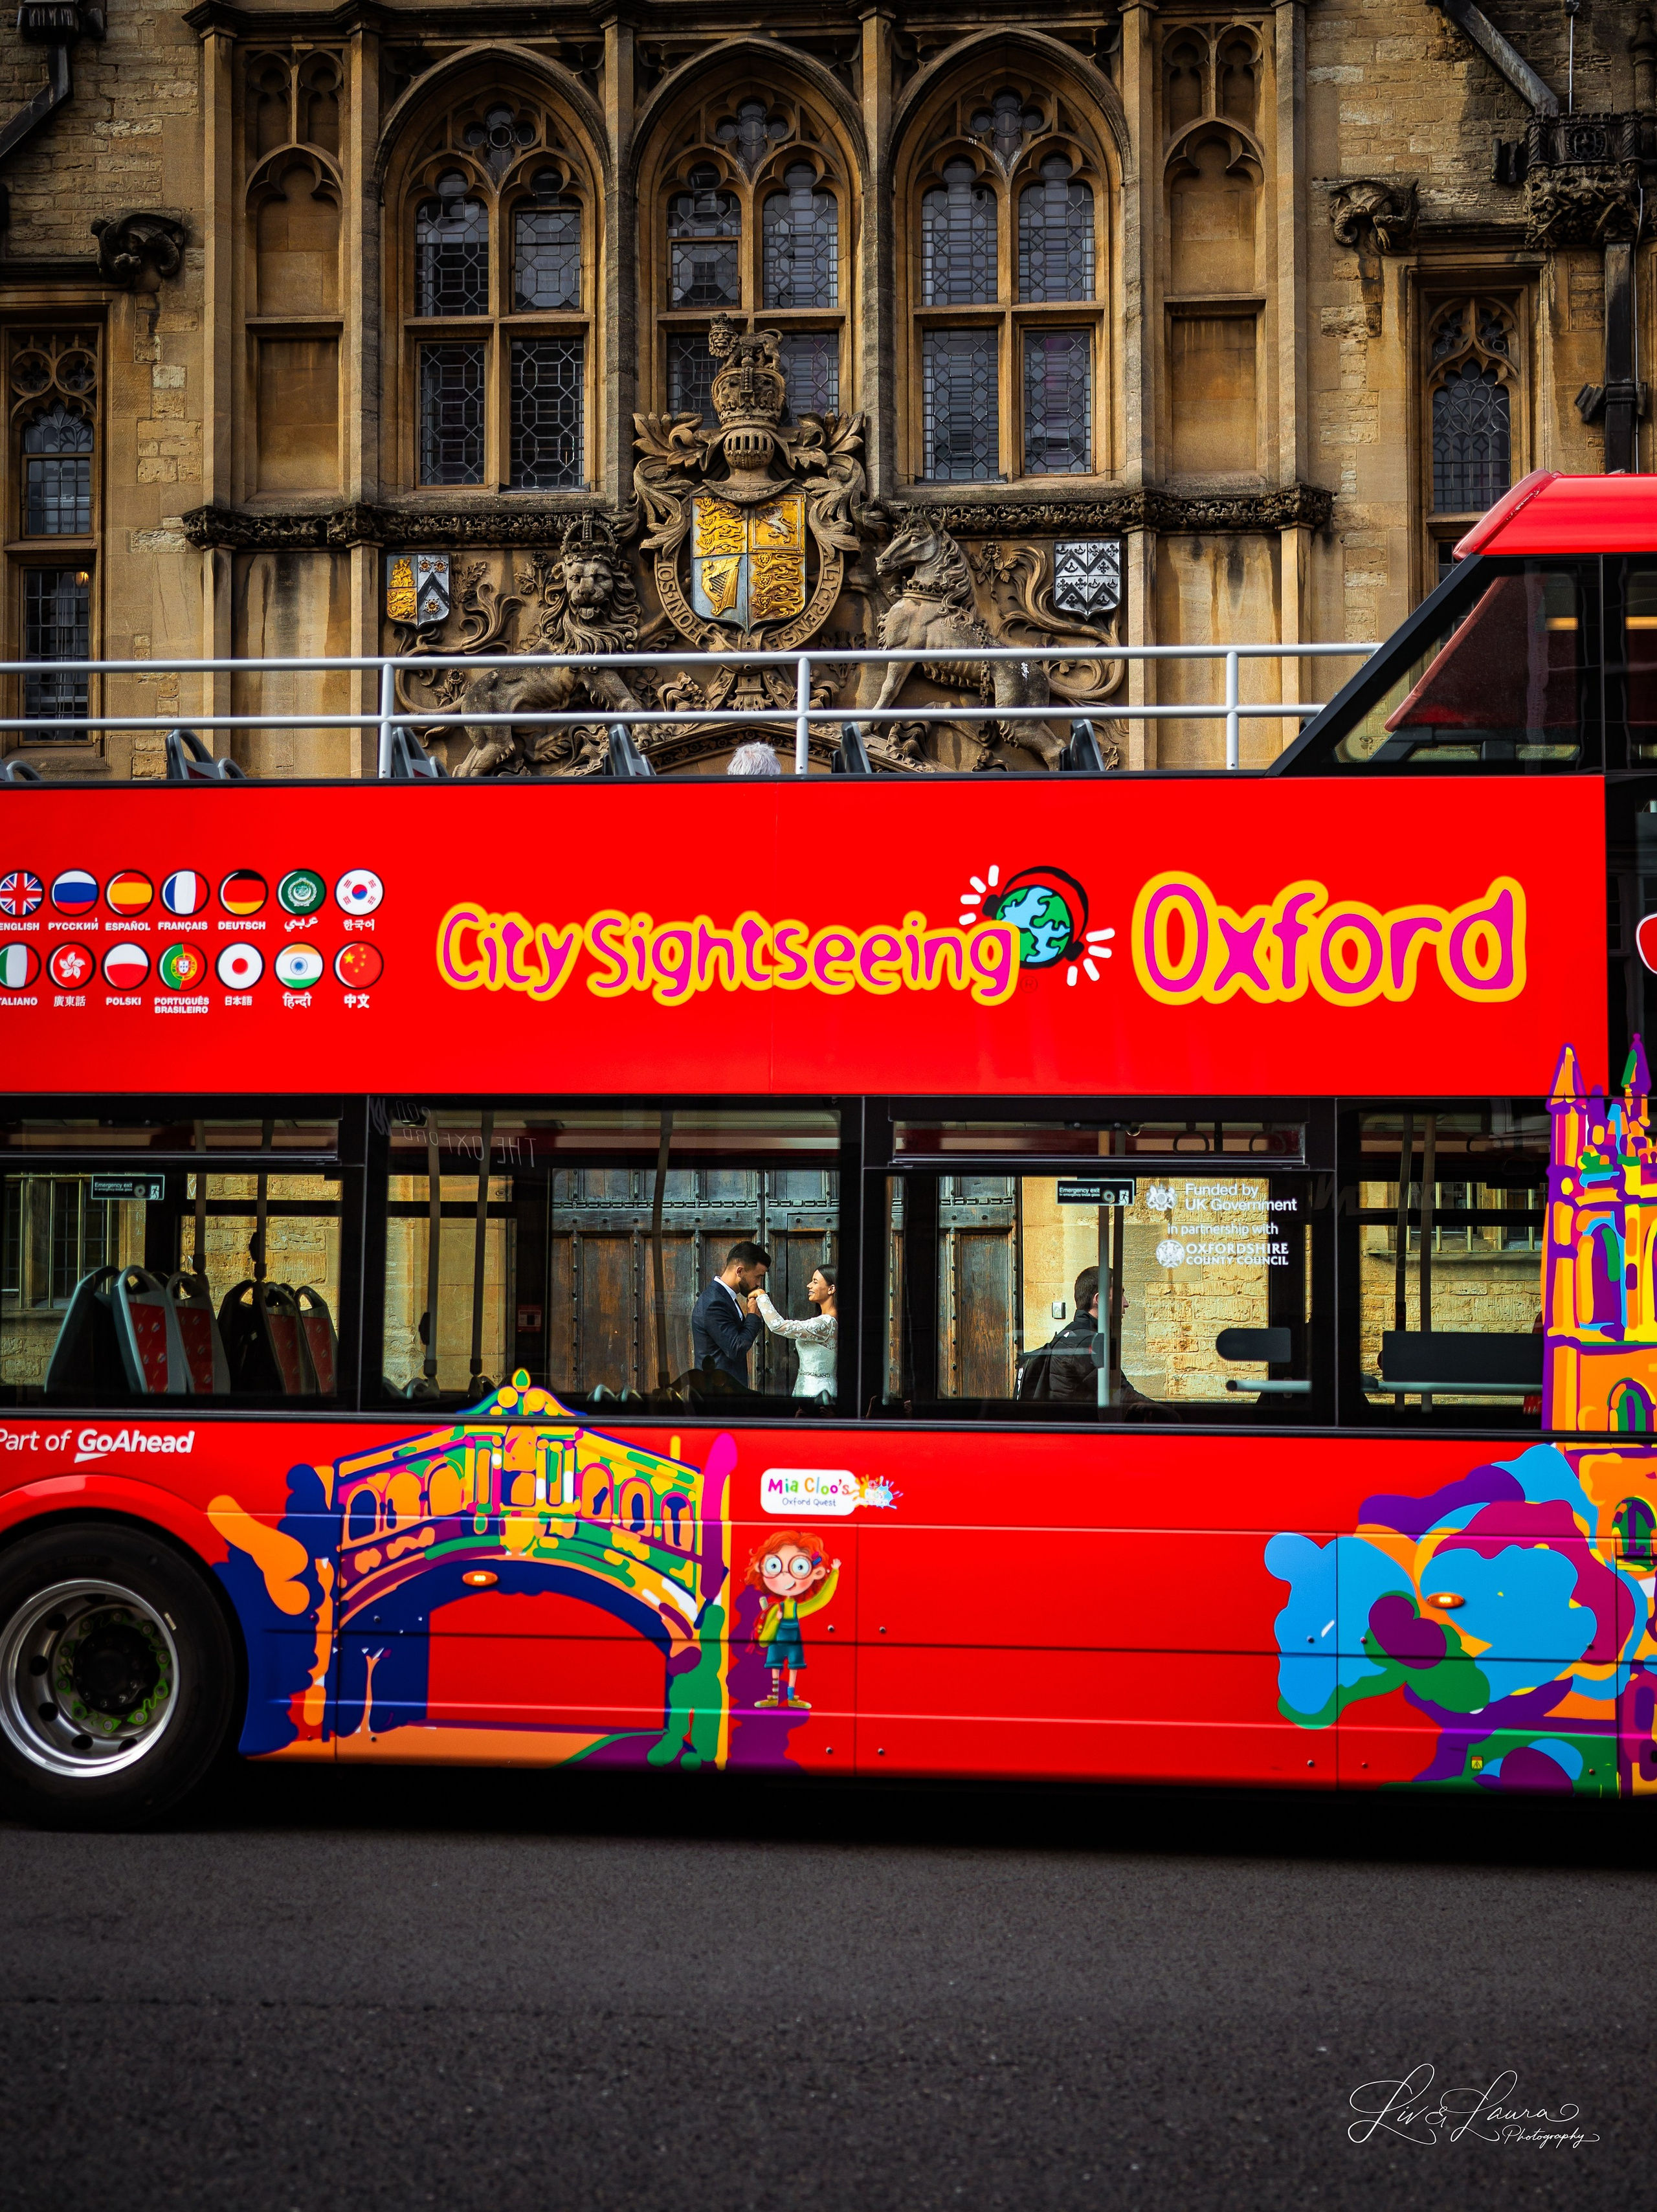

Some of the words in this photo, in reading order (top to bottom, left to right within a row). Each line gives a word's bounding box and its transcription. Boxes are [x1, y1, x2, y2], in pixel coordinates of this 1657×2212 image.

[658, 555, 677, 594] SOI
[0, 922, 39, 931] ENGLISH
[48, 917, 98, 930] РУССКИЙ
[105, 921, 150, 931] ESPAÑOL
[158, 921, 208, 932] FRANÇAIS
[217, 921, 266, 930] DEUTSCH
[284, 917, 318, 932] عربي
[343, 919, 375, 931] 한국어
[1131, 870, 1527, 1007] Oxford
[0, 998, 38, 1006] ALIANO
[54, 996, 85, 1007] 廣東話
[106, 997, 141, 1005] POLSKI
[154, 996, 209, 1005] PORTUGUÊS
[225, 996, 252, 1006] 日本語
[282, 992, 312, 1009] हिन्दी
[344, 994, 370, 1009] 中文
[154, 1005, 208, 1014] BRASILEIRO
[1185, 1183, 1237, 1196] Funded
[1242, 1183, 1259, 1198] by
[1185, 1199, 1207, 1211] UK
[1210, 1198, 1297, 1211] Government
[1167, 1223, 1177, 1234] in
[1181, 1222, 1249, 1236] partnership
[1252, 1222, 1279, 1234] with
[1186, 1242, 1289, 1255] OXFORDSHIRE
[1186, 1256, 1233, 1266] COUNTY
[1234, 1256, 1289, 1266] COUNCIL
[45, 1429, 72, 1451] of
[78, 1428, 195, 1453] GoAhead
[768, 1478, 799, 1495] Mia
[804, 1477, 851, 1496] Cloo's
[782, 1497, 810, 1506] Oxford
[813, 1498, 837, 1507] Quest
